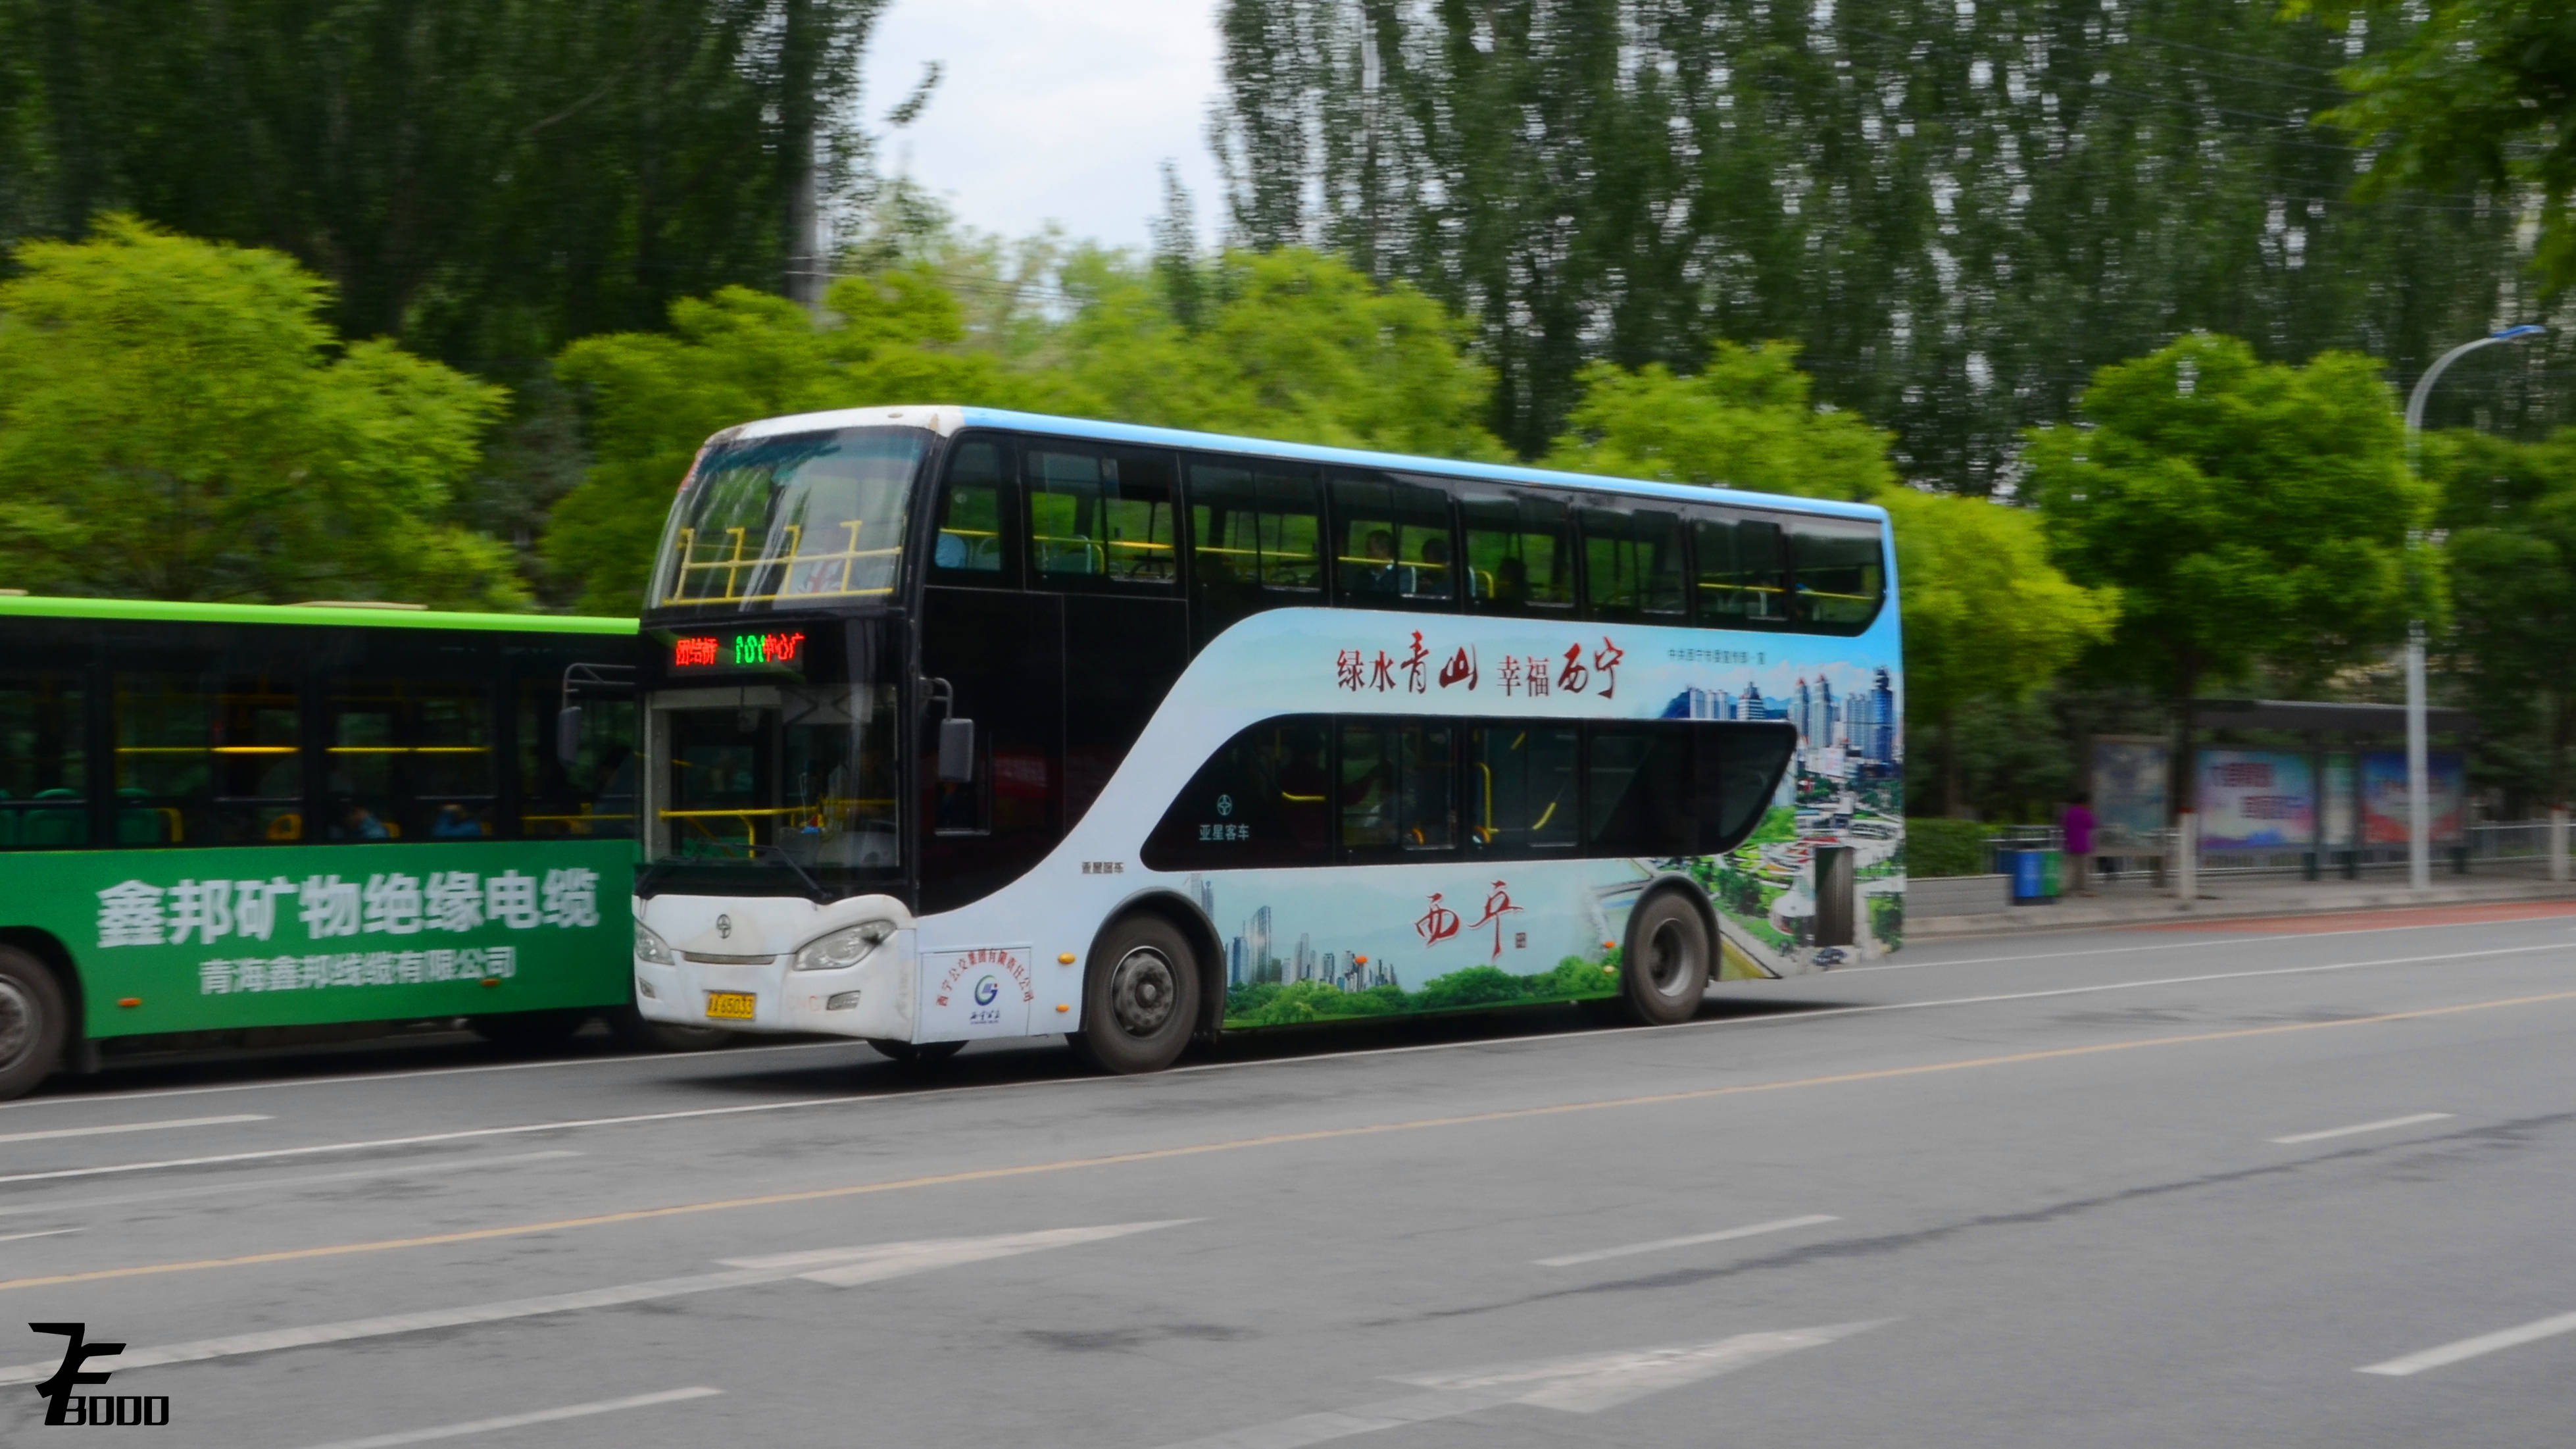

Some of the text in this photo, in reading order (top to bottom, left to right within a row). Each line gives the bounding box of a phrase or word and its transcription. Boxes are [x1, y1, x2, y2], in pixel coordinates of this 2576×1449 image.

[1337, 630, 1623, 699] 绿水青山 幸福西宁
[1199, 824, 1249, 841] 亚星客车
[96, 868, 601, 948] 鑫邦矿物绝缘电缆
[199, 946, 517, 996] 青海鑫邦线缆有限公司
